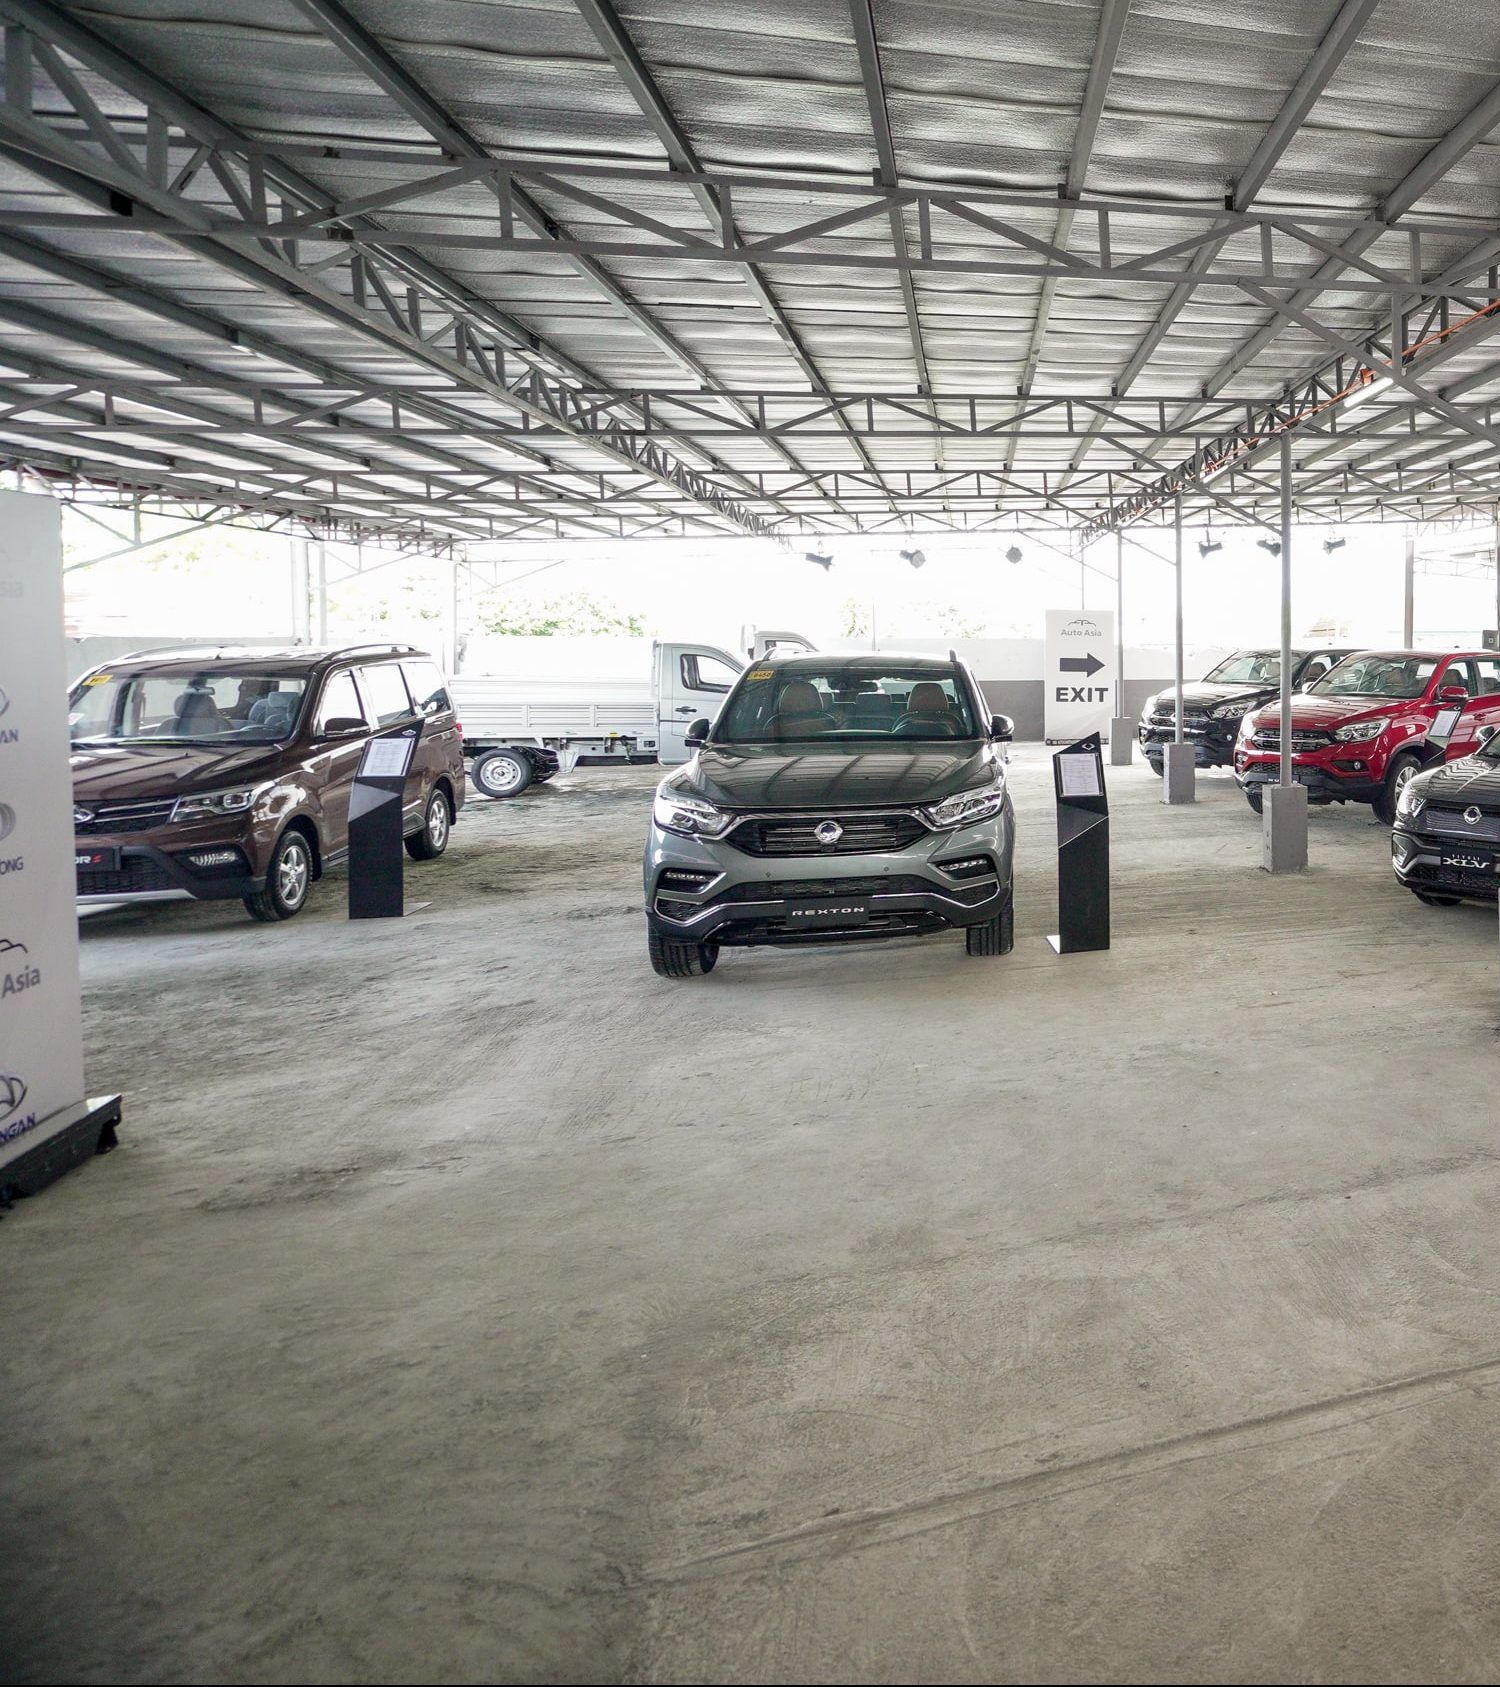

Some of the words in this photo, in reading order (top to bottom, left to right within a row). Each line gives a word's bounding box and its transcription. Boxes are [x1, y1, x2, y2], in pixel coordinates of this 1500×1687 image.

[1084, 629, 1102, 637] Asia
[1056, 687, 1109, 703] EXIT
[1443, 857, 1490, 869] XLV
[792, 907, 865, 916] REXTON
[2, 964, 41, 998] Asia
